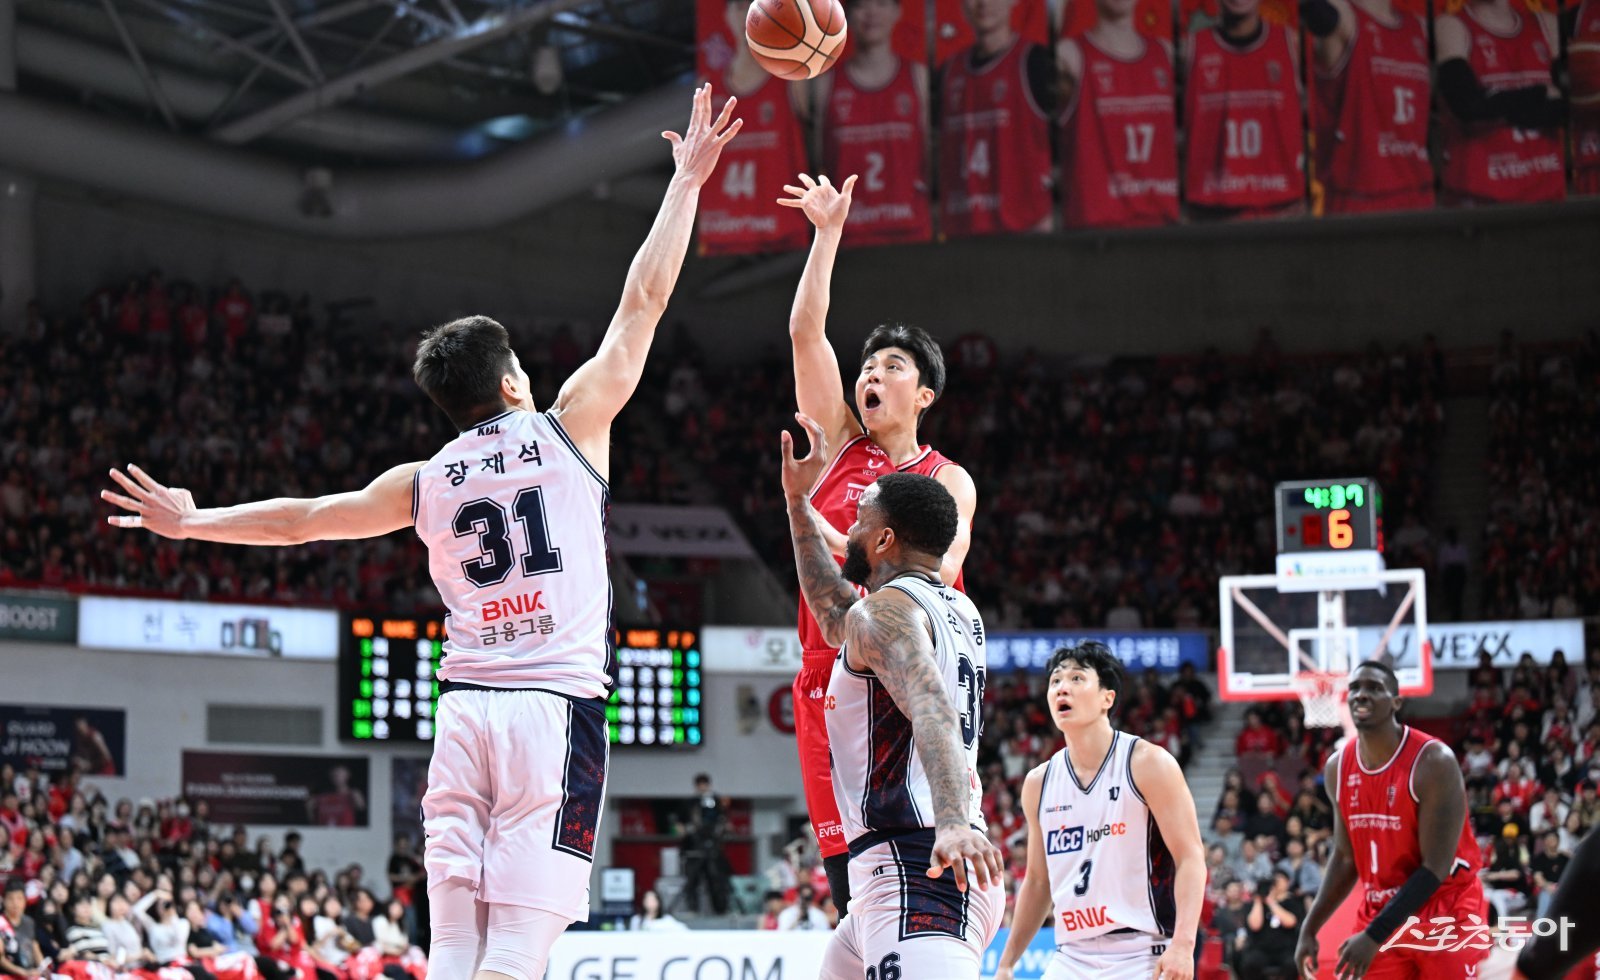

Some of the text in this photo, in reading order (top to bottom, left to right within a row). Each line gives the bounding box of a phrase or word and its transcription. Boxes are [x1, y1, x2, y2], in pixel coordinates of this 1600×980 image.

[1125, 123, 1154, 162] 17
[1225, 119, 1261, 159] 10
[722, 161, 756, 199] 44
[865, 152, 885, 191] 2
[444, 440, 543, 487] 장재석
[1304, 484, 1364, 509] 4:37
[451, 485, 563, 588] 31
[1328, 509, 1353, 549] 6
[481, 590, 546, 622] BNK
[479, 614, 556, 646] 금융그룹
[1049, 825, 1082, 852] KCC
[1369, 839, 1379, 875] 1
[1074, 859, 1092, 897] 3
[1062, 905, 1115, 932] BNK
